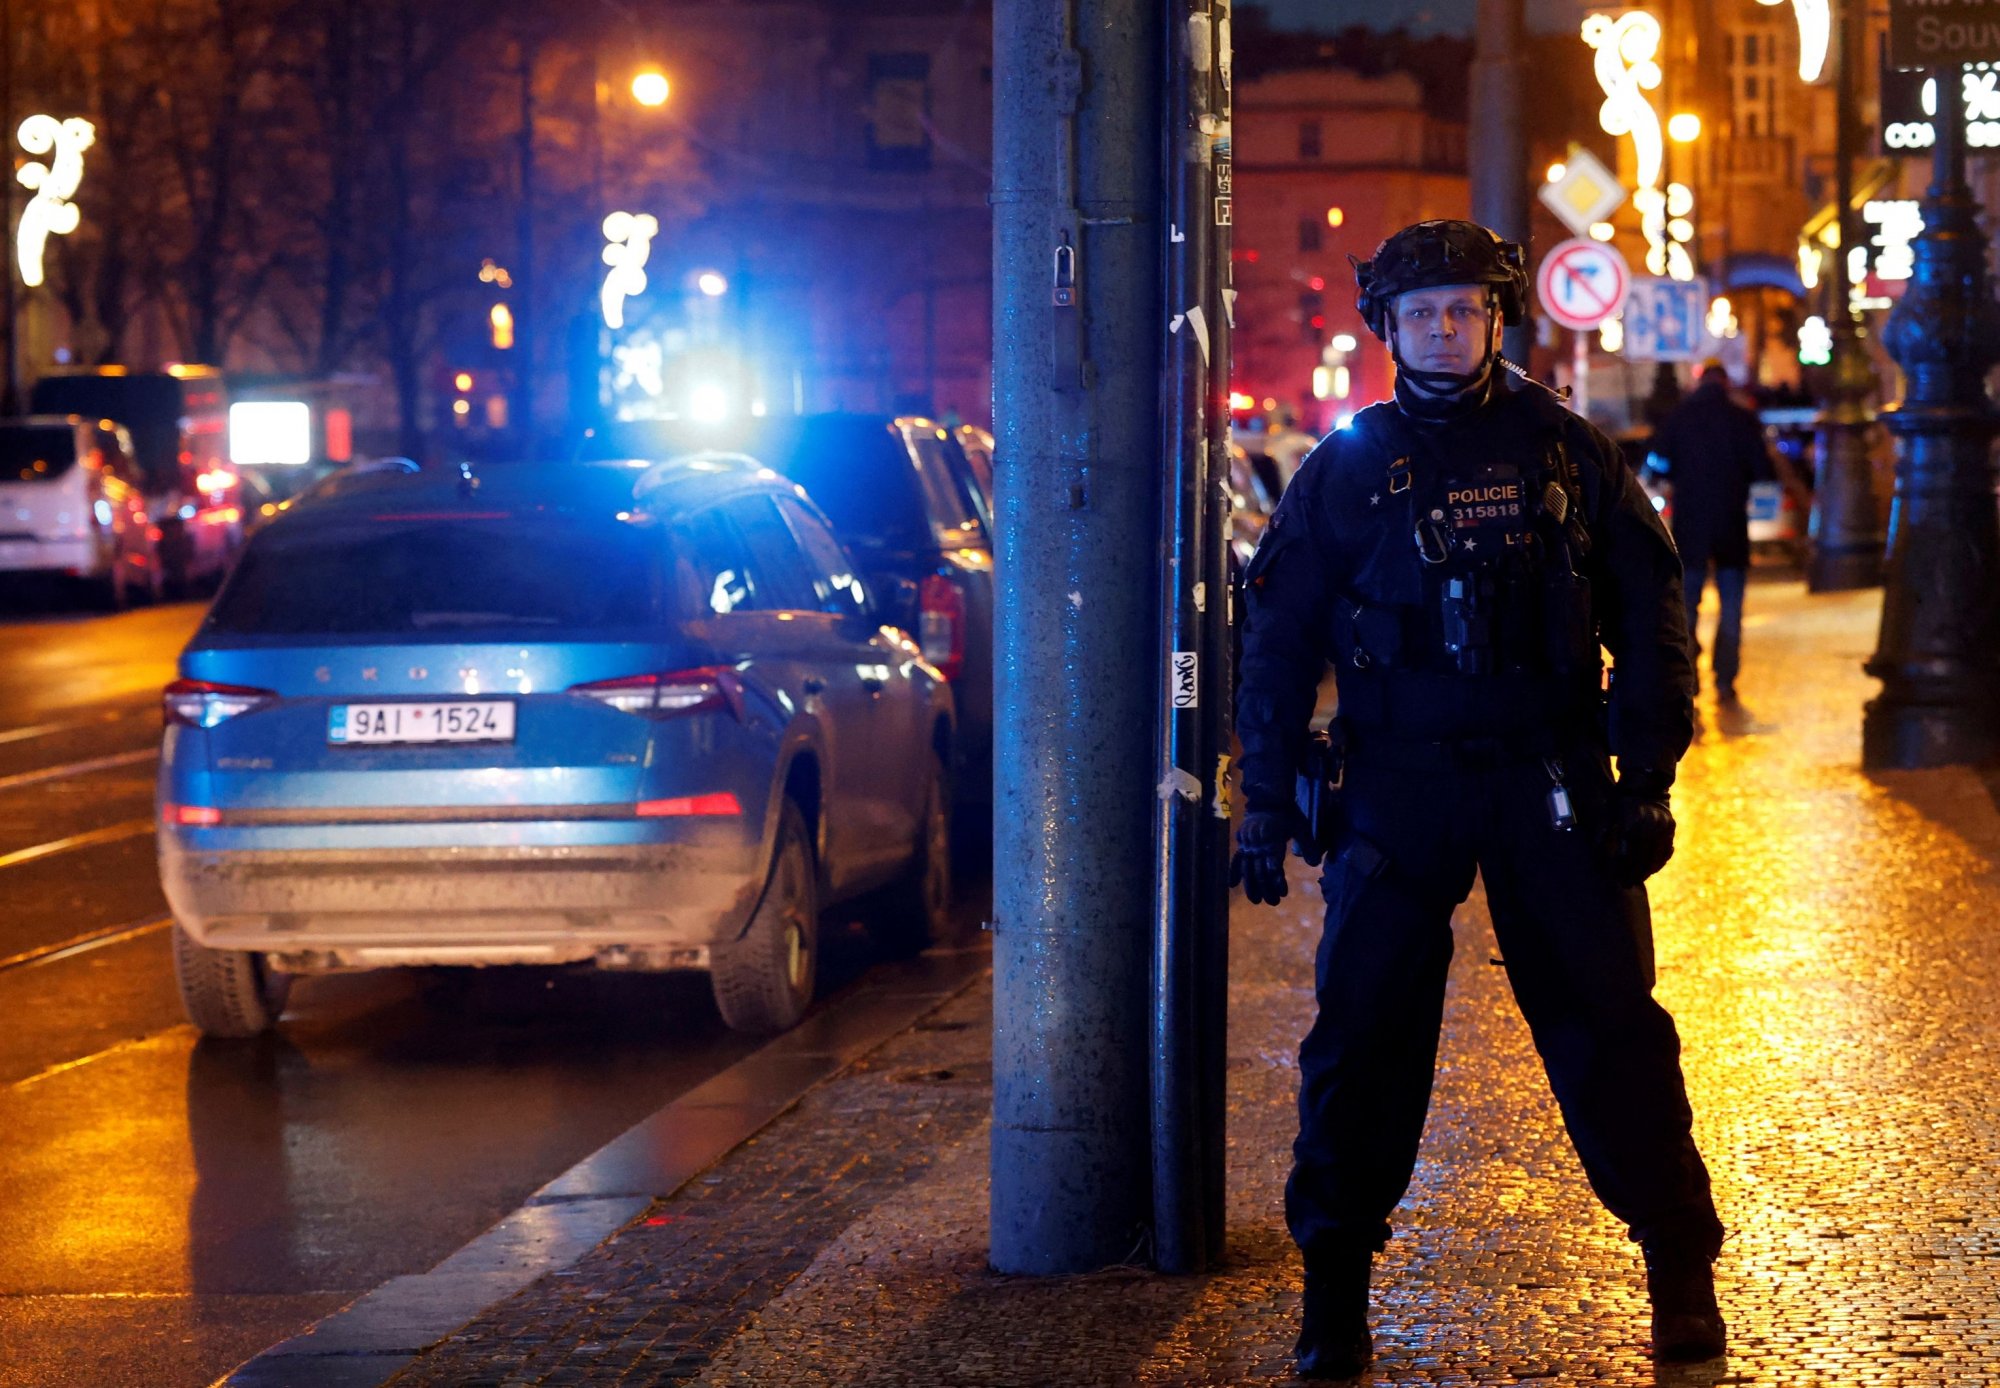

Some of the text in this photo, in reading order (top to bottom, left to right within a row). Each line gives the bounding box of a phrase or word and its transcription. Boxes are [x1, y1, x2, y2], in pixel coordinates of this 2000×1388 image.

[1448, 485, 1519, 505] POLICIE
[1453, 503, 1519, 520] 315818
[355, 709, 401, 735] 9AI
[432, 706, 497, 734] 1524
